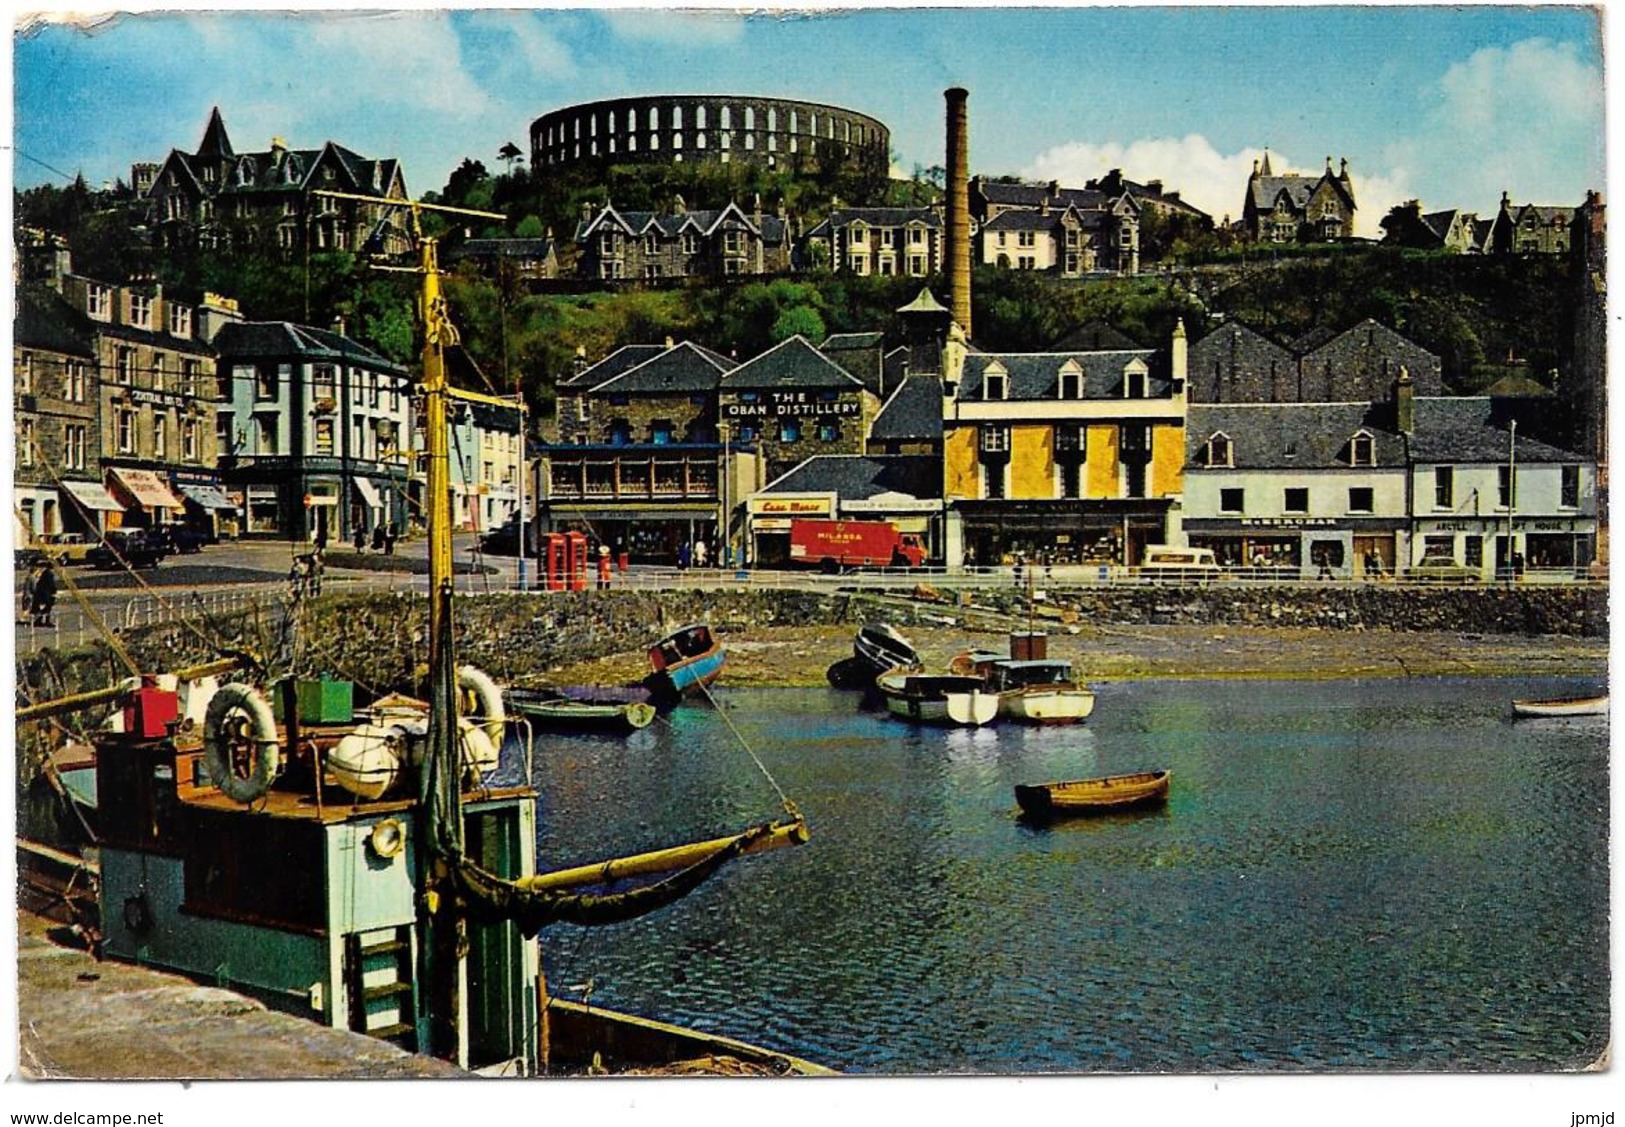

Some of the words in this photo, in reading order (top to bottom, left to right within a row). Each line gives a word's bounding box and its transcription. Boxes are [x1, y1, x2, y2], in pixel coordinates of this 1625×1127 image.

[772, 393, 806, 402] THE
[729, 405, 767, 415] OBAN
[777, 402, 859, 415] DISTILLERY
[1436, 522, 1467, 531] ARGYLL
[1534, 521, 1561, 530] HOUSE
